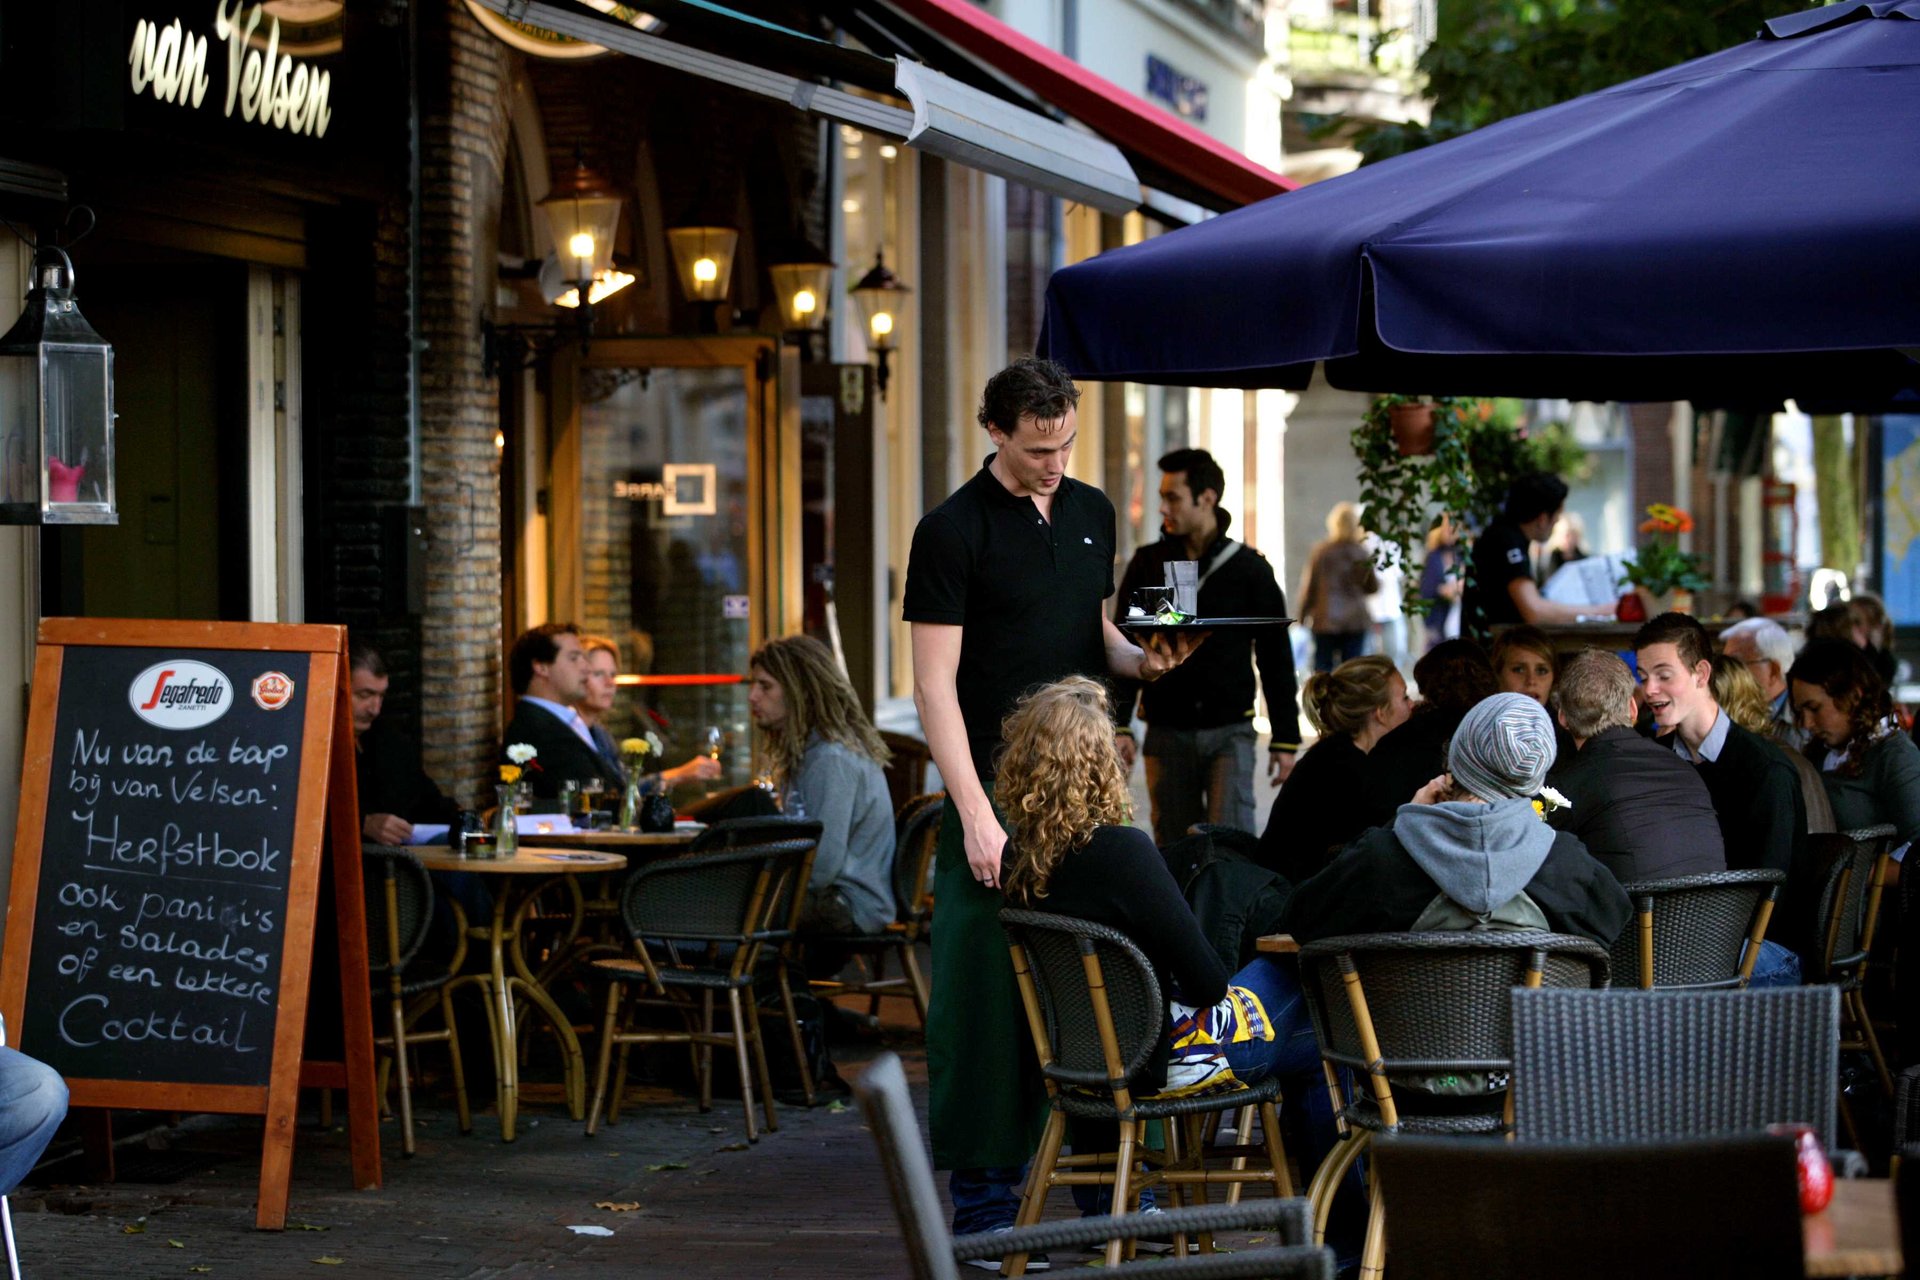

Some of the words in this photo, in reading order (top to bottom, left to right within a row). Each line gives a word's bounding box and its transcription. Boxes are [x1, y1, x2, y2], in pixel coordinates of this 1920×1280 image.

[128, 18, 209, 109] van
[216, 0, 332, 138] Velsen
[141, 670, 223, 710] Segafredo
[72, 728, 110, 766] Nu
[122, 744, 174, 767] van
[186, 740, 219, 764] de
[229, 737, 289, 774] tap
[69, 770, 100, 805] bij
[112, 779, 162, 798] van
[72, 810, 280, 875] Herfstbok
[57, 920, 107, 939] en
[58, 948, 98, 984] of
[108, 964, 162, 987] een
[175, 967, 271, 1005] lekkere
[59, 994, 257, 1052] Cocktail
